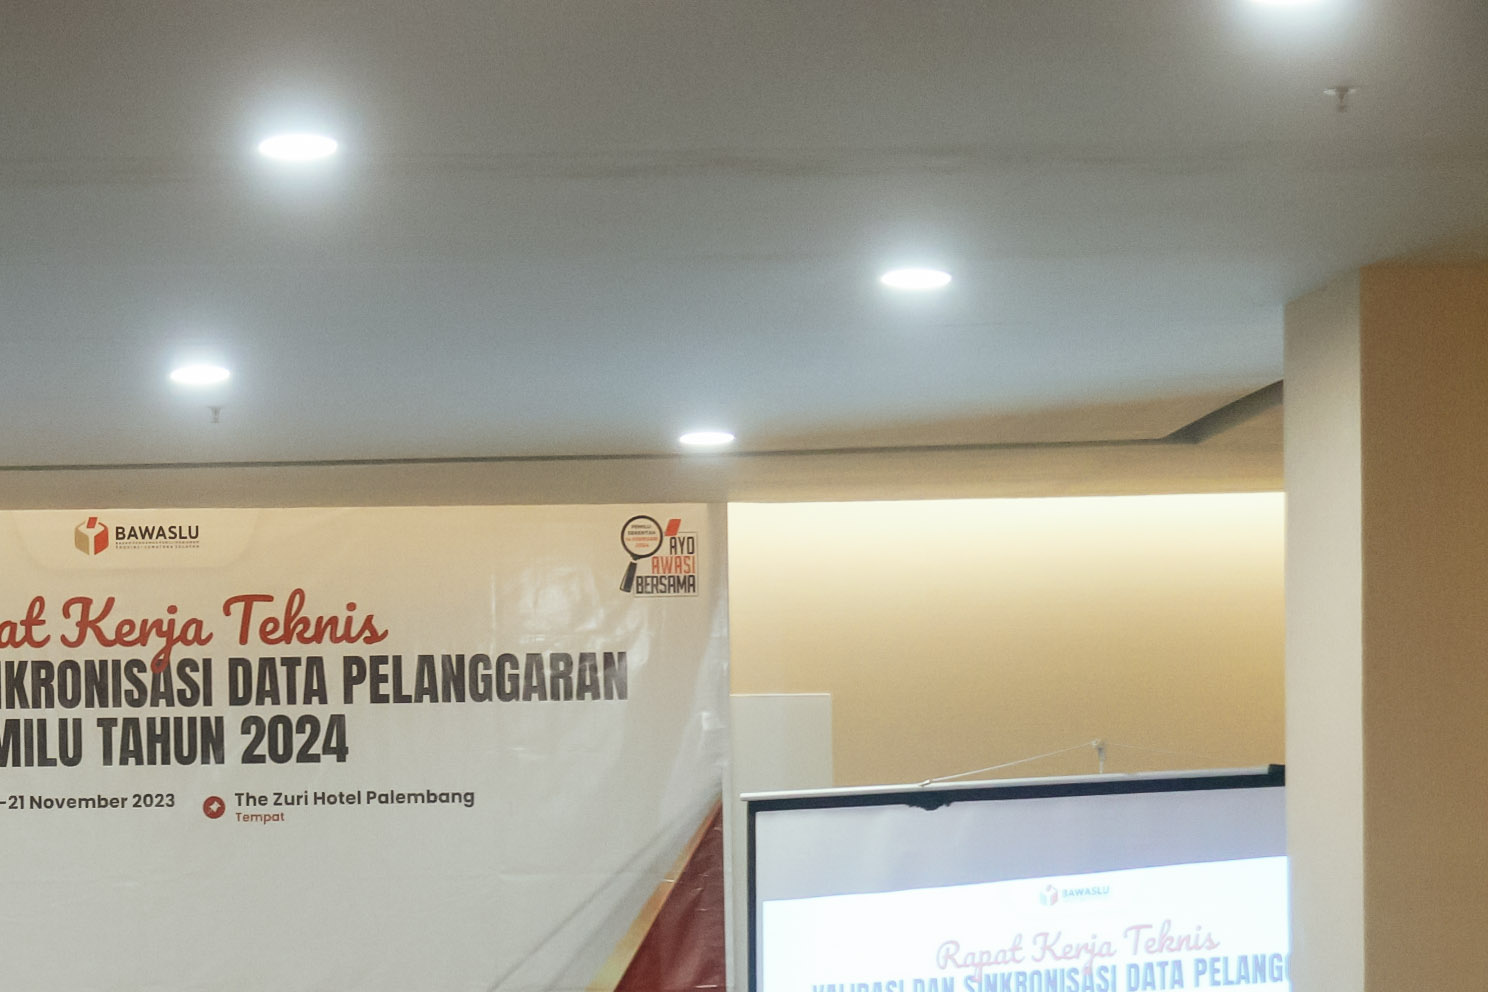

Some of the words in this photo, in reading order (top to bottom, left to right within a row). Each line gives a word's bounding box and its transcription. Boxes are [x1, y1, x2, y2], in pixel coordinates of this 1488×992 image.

[115, 525, 199, 540] BAWASLU
[669, 536, 695, 555] AYO
[651, 556, 696, 574] AWASI
[636, 575, 696, 594] BERSAMA
[61, 596, 213, 674] Kerja
[223, 588, 389, 646] Teknis
[228, 655, 329, 707] DATA
[342, 651, 629, 705] PELANGGARAN
[96, 715, 226, 767] TAHUN
[240, 713, 349, 765] 2024
[29, 794, 128, 810] November
[132, 793, 176, 808] 2023
[235, 792, 268, 807] The
[273, 790, 309, 806] Zuri
[313, 790, 361, 806] Hotel
[366, 789, 475, 808] Palembang
[236, 812, 285, 825] Tempat
[936, 933, 1026, 984] Rapat
[1031, 930, 1118, 976] Kerja
[1123, 918, 1221, 956] Teknis
[1126, 959, 1185, 992] DATA
